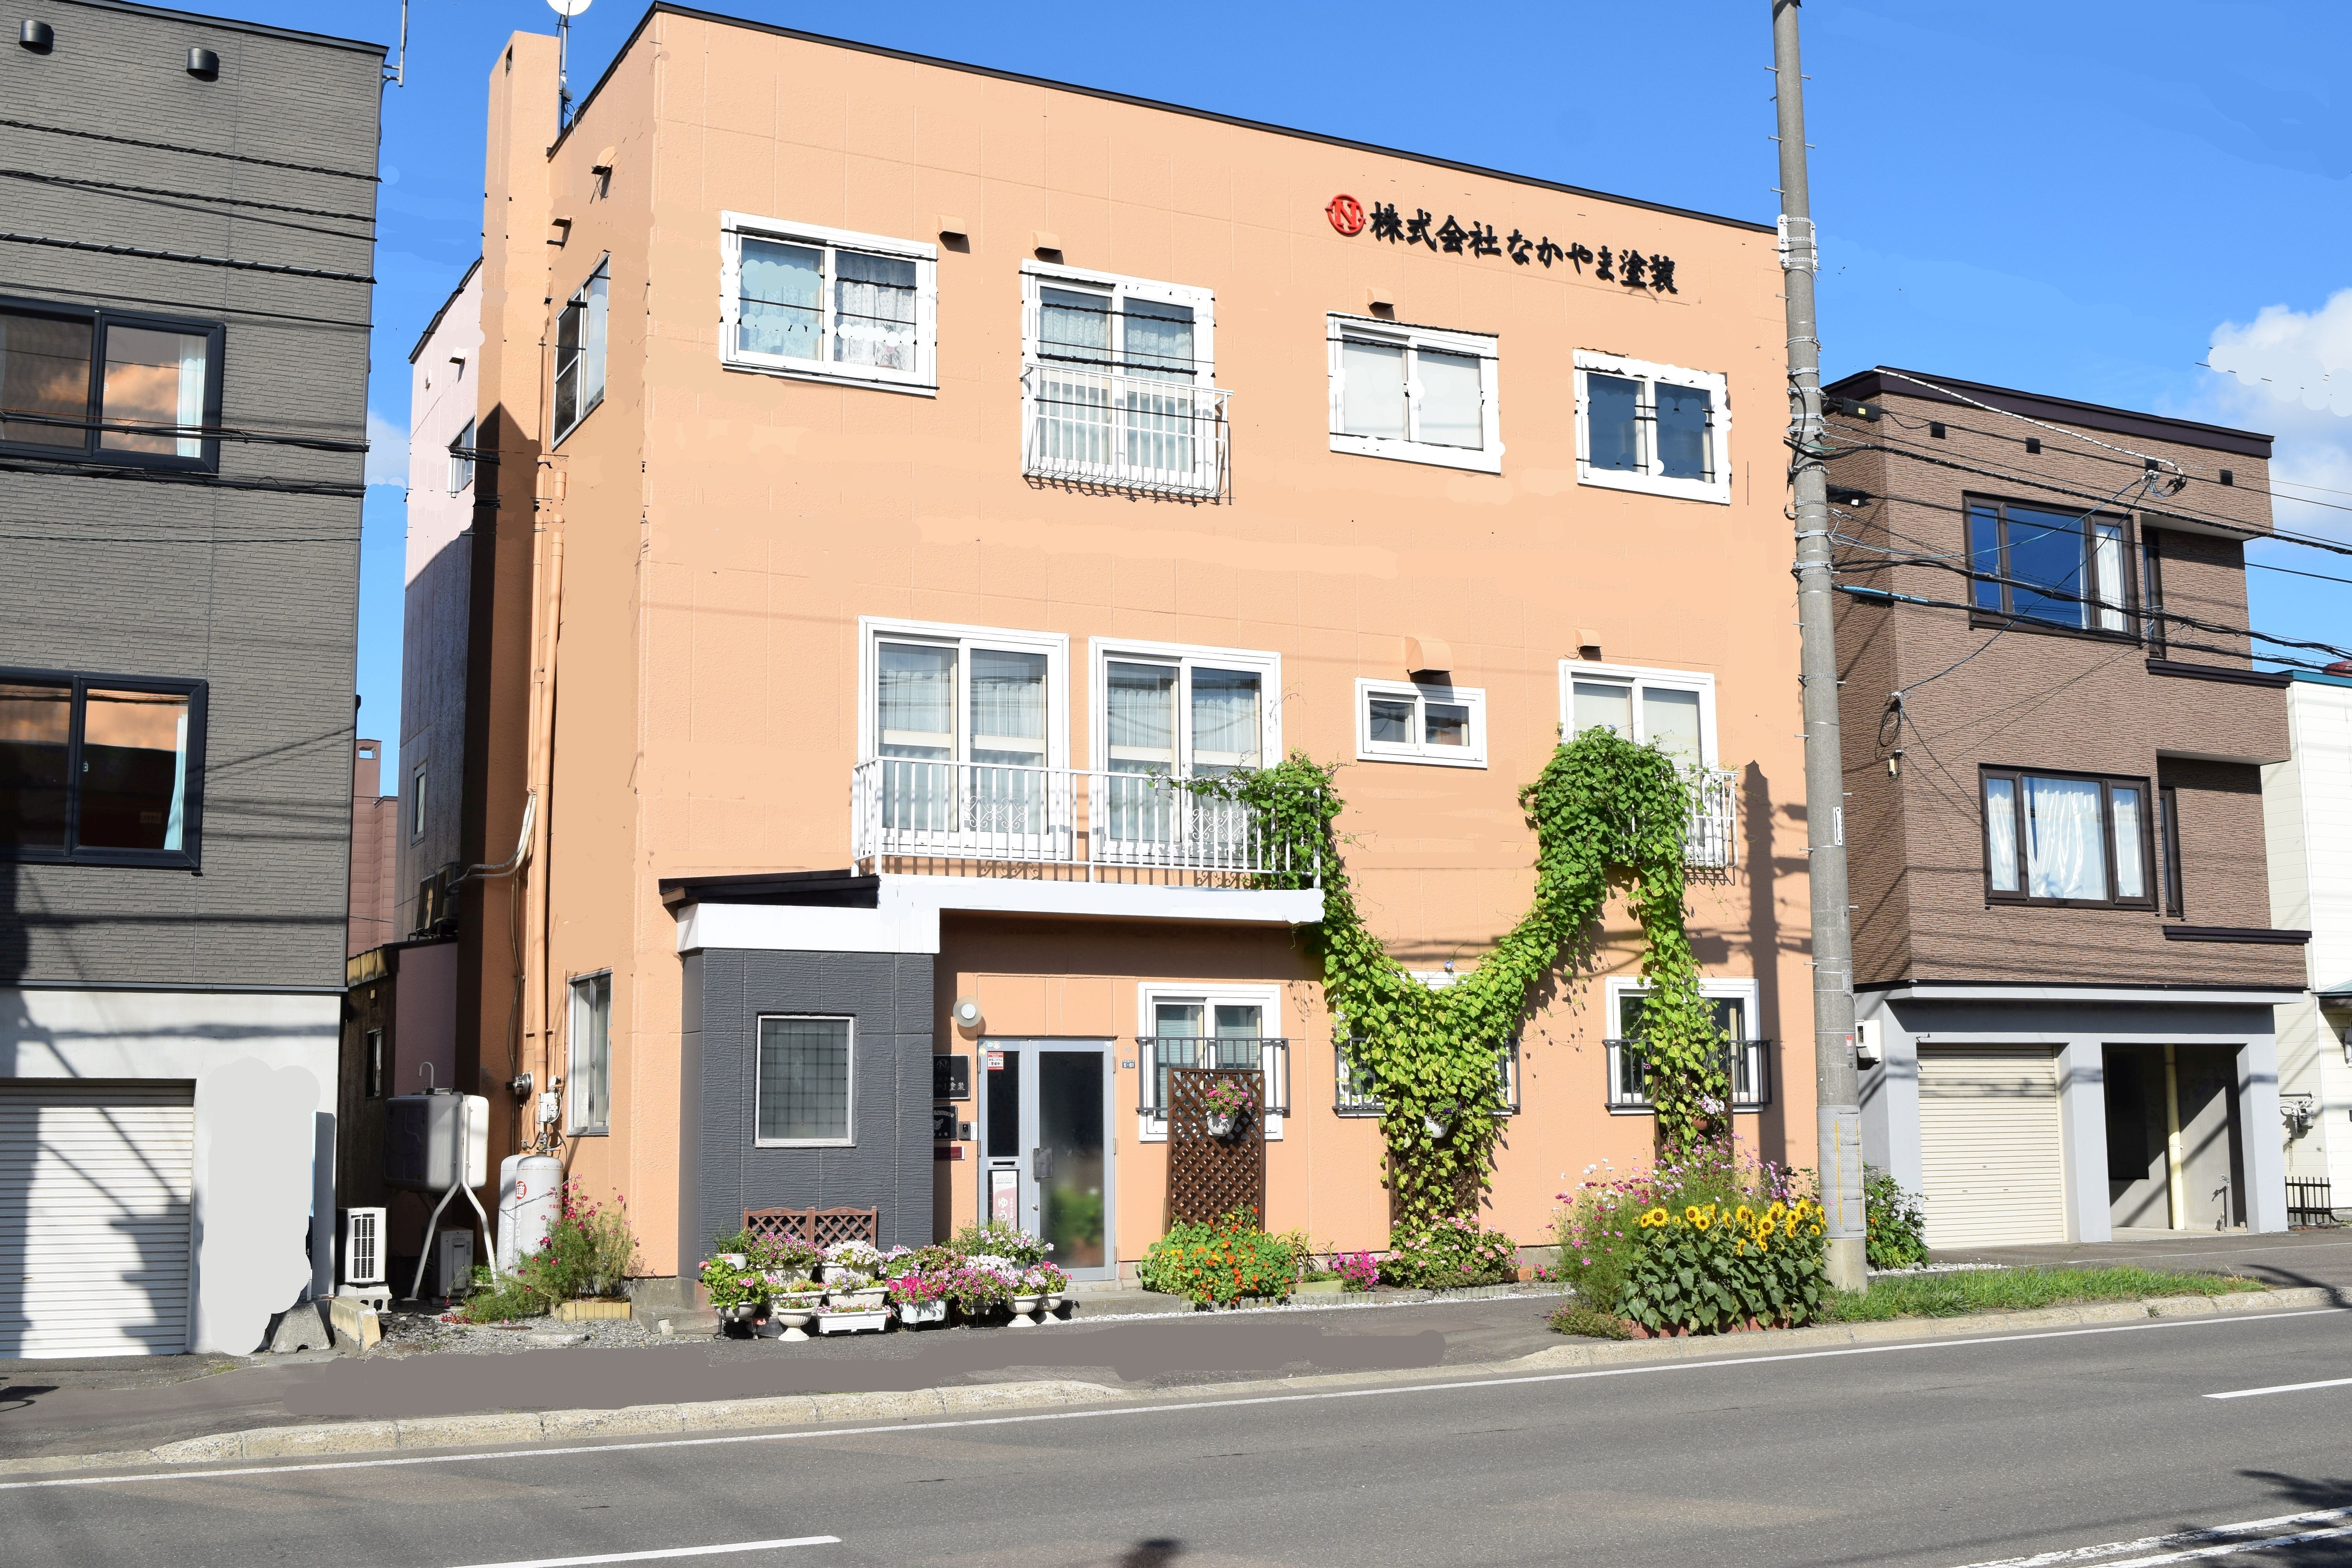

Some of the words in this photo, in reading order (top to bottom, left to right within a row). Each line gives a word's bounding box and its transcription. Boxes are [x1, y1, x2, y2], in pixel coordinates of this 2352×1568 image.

[1369, 201, 1678, 294] 株式会社なかやま塗装
